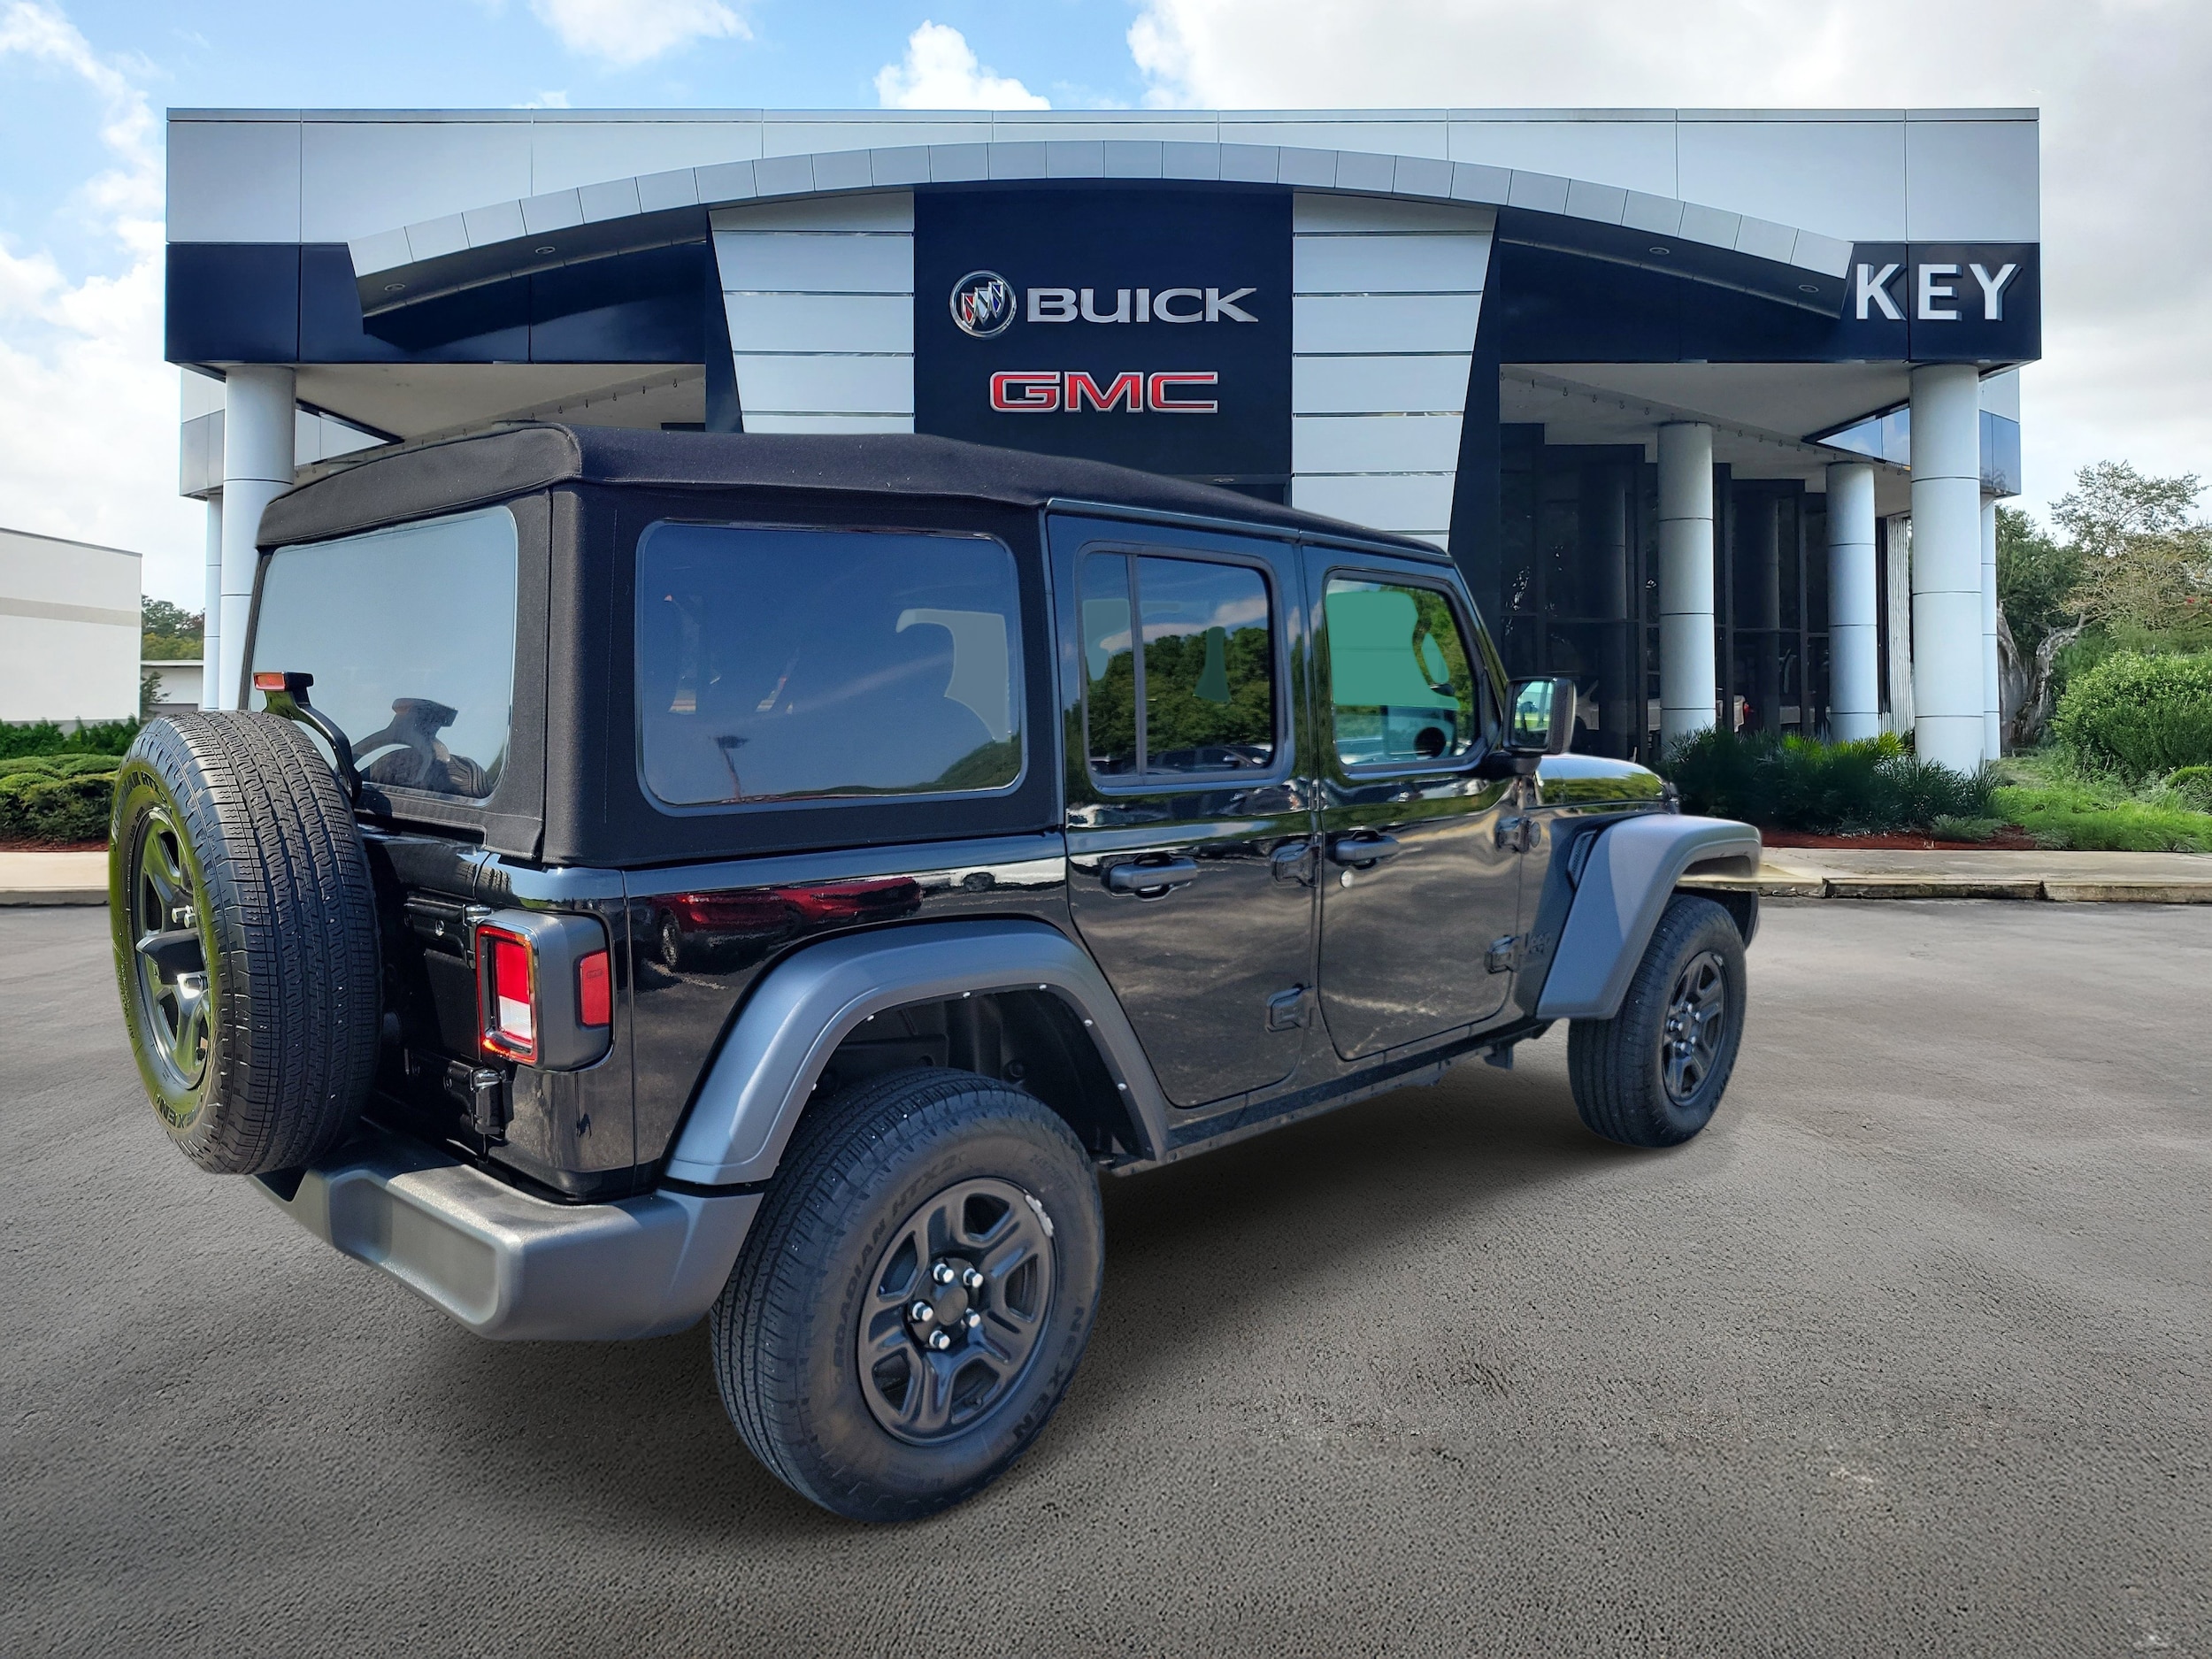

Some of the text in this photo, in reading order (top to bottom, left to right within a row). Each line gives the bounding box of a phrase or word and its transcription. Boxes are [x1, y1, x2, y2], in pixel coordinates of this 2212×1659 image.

[1027, 288, 1259, 323] BUICK
[1855, 263, 2019, 321] KEY
[989, 371, 1218, 413] GMC
[832, 1217, 886, 1369] ROADIAN
[1012, 1305, 1085, 1440] NEXEN
